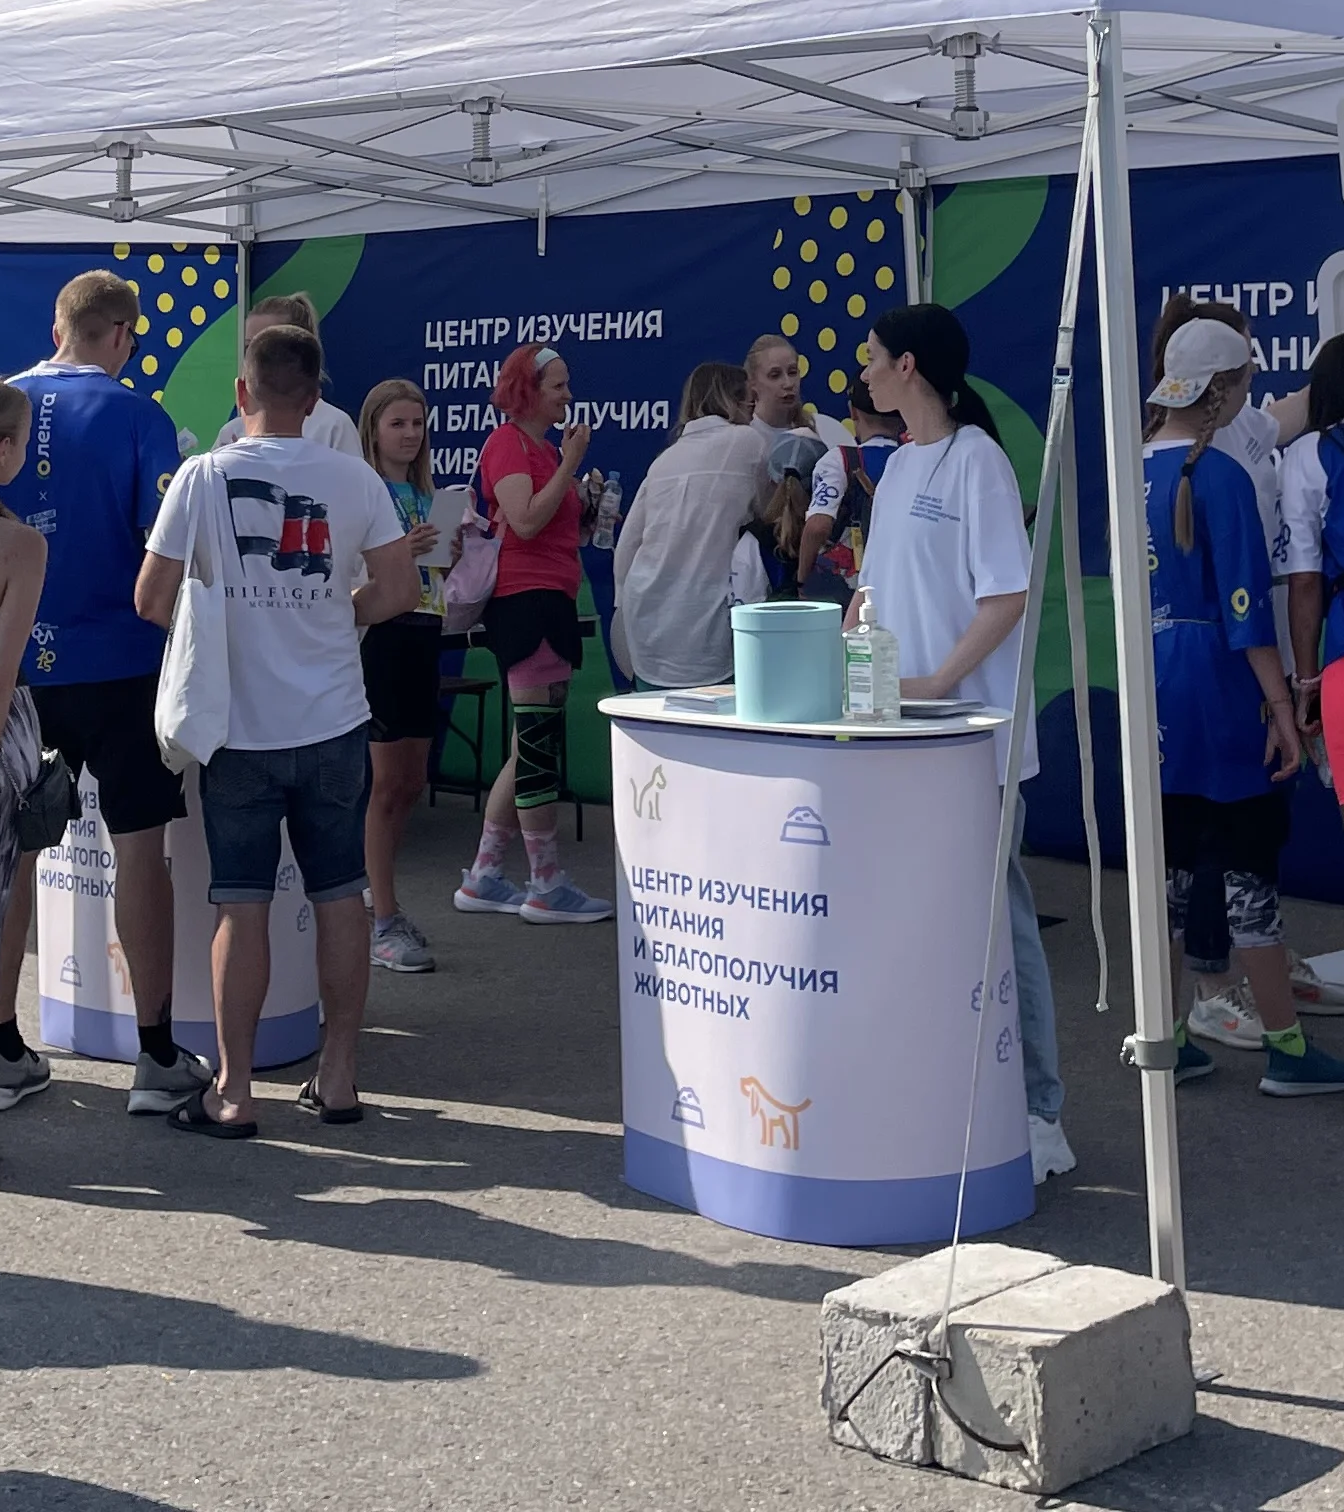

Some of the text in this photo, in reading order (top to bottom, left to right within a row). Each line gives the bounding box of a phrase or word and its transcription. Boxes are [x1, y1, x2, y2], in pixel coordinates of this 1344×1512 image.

[425, 309, 663, 352] ЦЕНТР ИЗУЧЕНИЯ
[224, 586, 333, 600] HILFIGER
[39, 868, 116, 899] ЖИВОТНЫХ
[631, 865, 828, 918] ЦЕНТР ИЗУЧЕНИЯ
[632, 901, 724, 941] ПИТАНИЯ
[633, 936, 839, 994] И БЛАГОПОЛУЧИЯ
[634, 971, 751, 1020] ЖИВОТНЫХ
